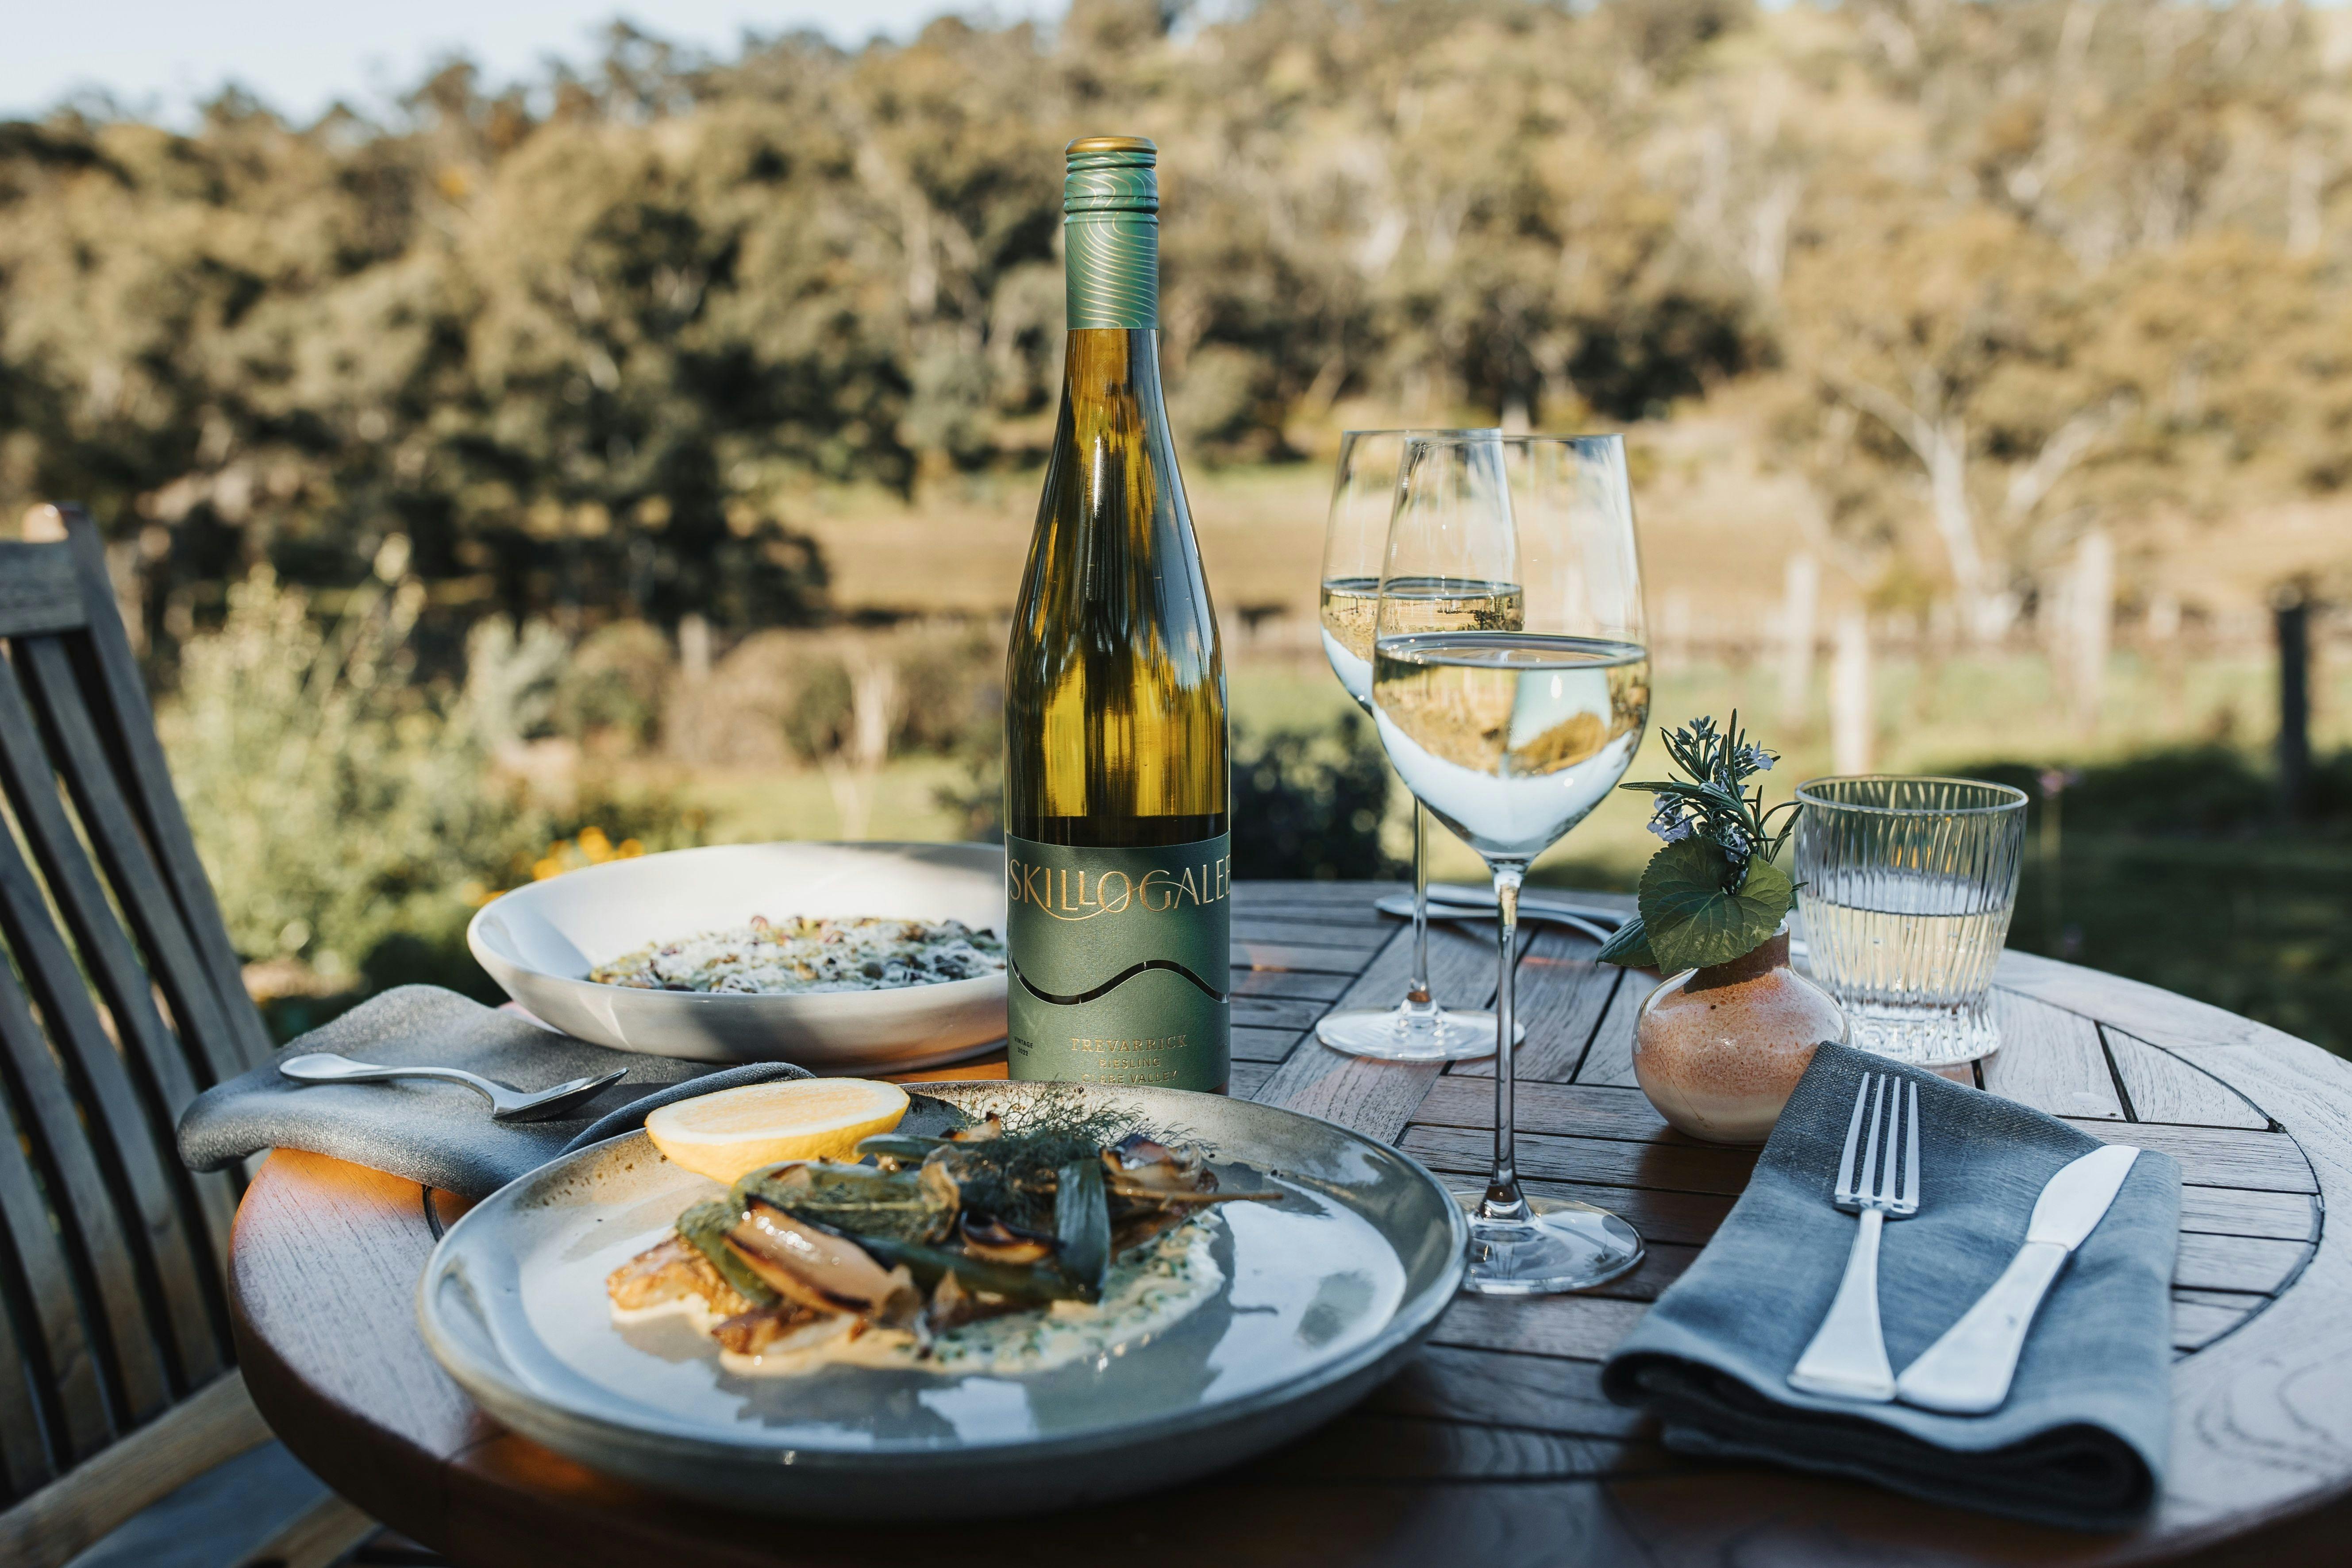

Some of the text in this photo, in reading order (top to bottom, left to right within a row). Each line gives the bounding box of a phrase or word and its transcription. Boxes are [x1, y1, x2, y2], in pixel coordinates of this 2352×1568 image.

[1014, 1036, 1034, 1048] VINTAGE
[1070, 1035, 1187, 1052] TREVARRICK
[1099, 1057, 1160, 1069] RIESLING
[1082, 1070, 1177, 1084] CLARE VALLEY
